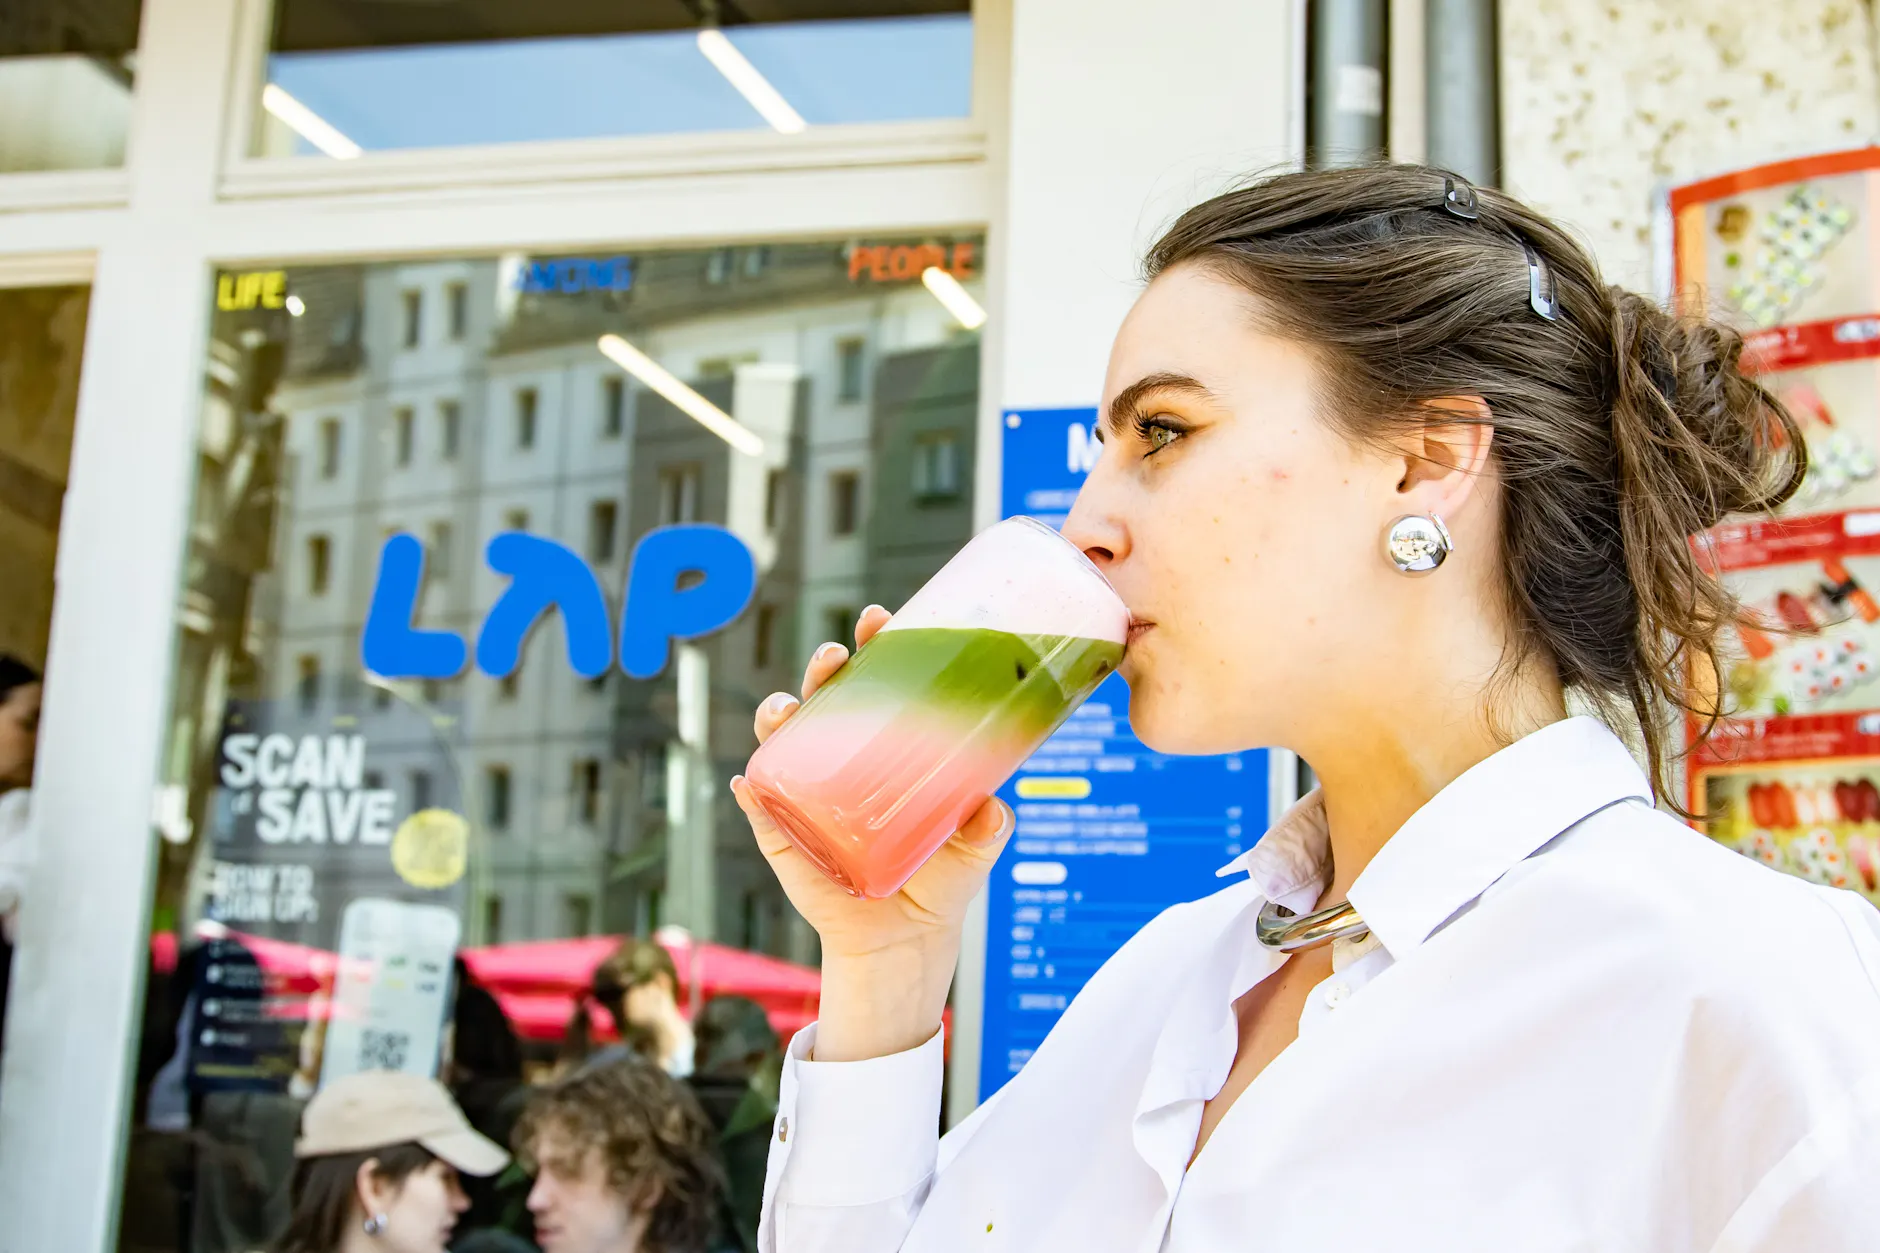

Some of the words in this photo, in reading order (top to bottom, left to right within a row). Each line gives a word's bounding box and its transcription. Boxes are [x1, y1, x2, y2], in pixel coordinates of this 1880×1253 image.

[217, 271, 287, 312] LIFE
[361, 522, 757, 680] LAP
[220, 733, 366, 789] SCAN
[256, 788, 396, 844] SAVE
